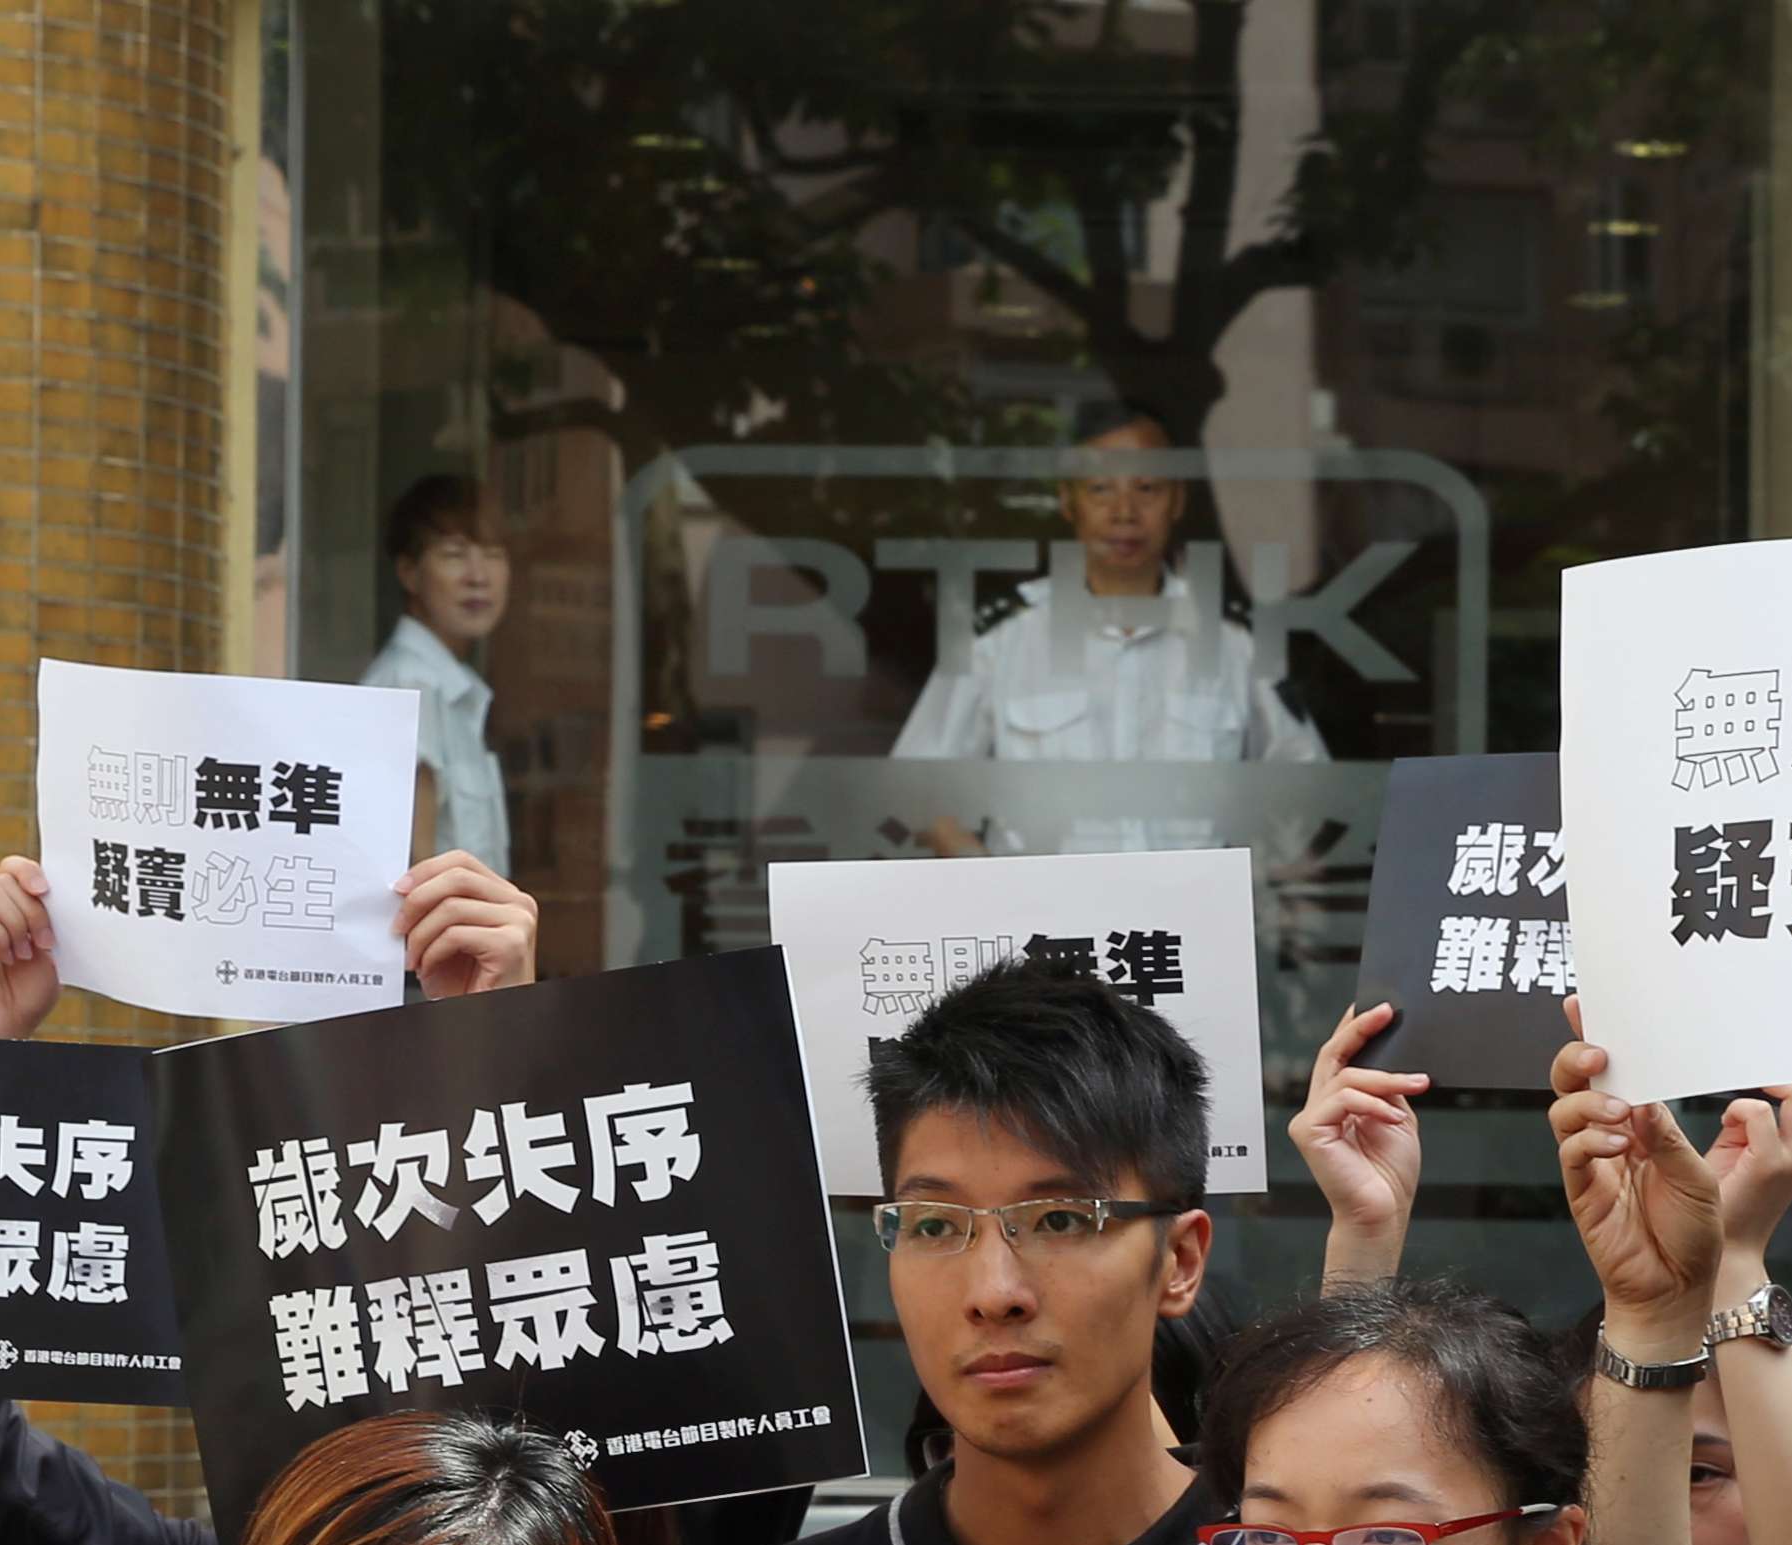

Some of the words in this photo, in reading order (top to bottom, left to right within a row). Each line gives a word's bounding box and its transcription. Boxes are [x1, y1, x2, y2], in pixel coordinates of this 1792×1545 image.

[707, 538, 1420, 682] RTHK
[88, 746, 342, 835] 無則無準
[92, 838, 336, 931] 疑竇必生
[248, 1081, 702, 1260] 歲次失序
[268, 1231, 735, 1412] 難釋眾慮
[606, 1405, 832, 1456] 香港電台節目製作人員工會
